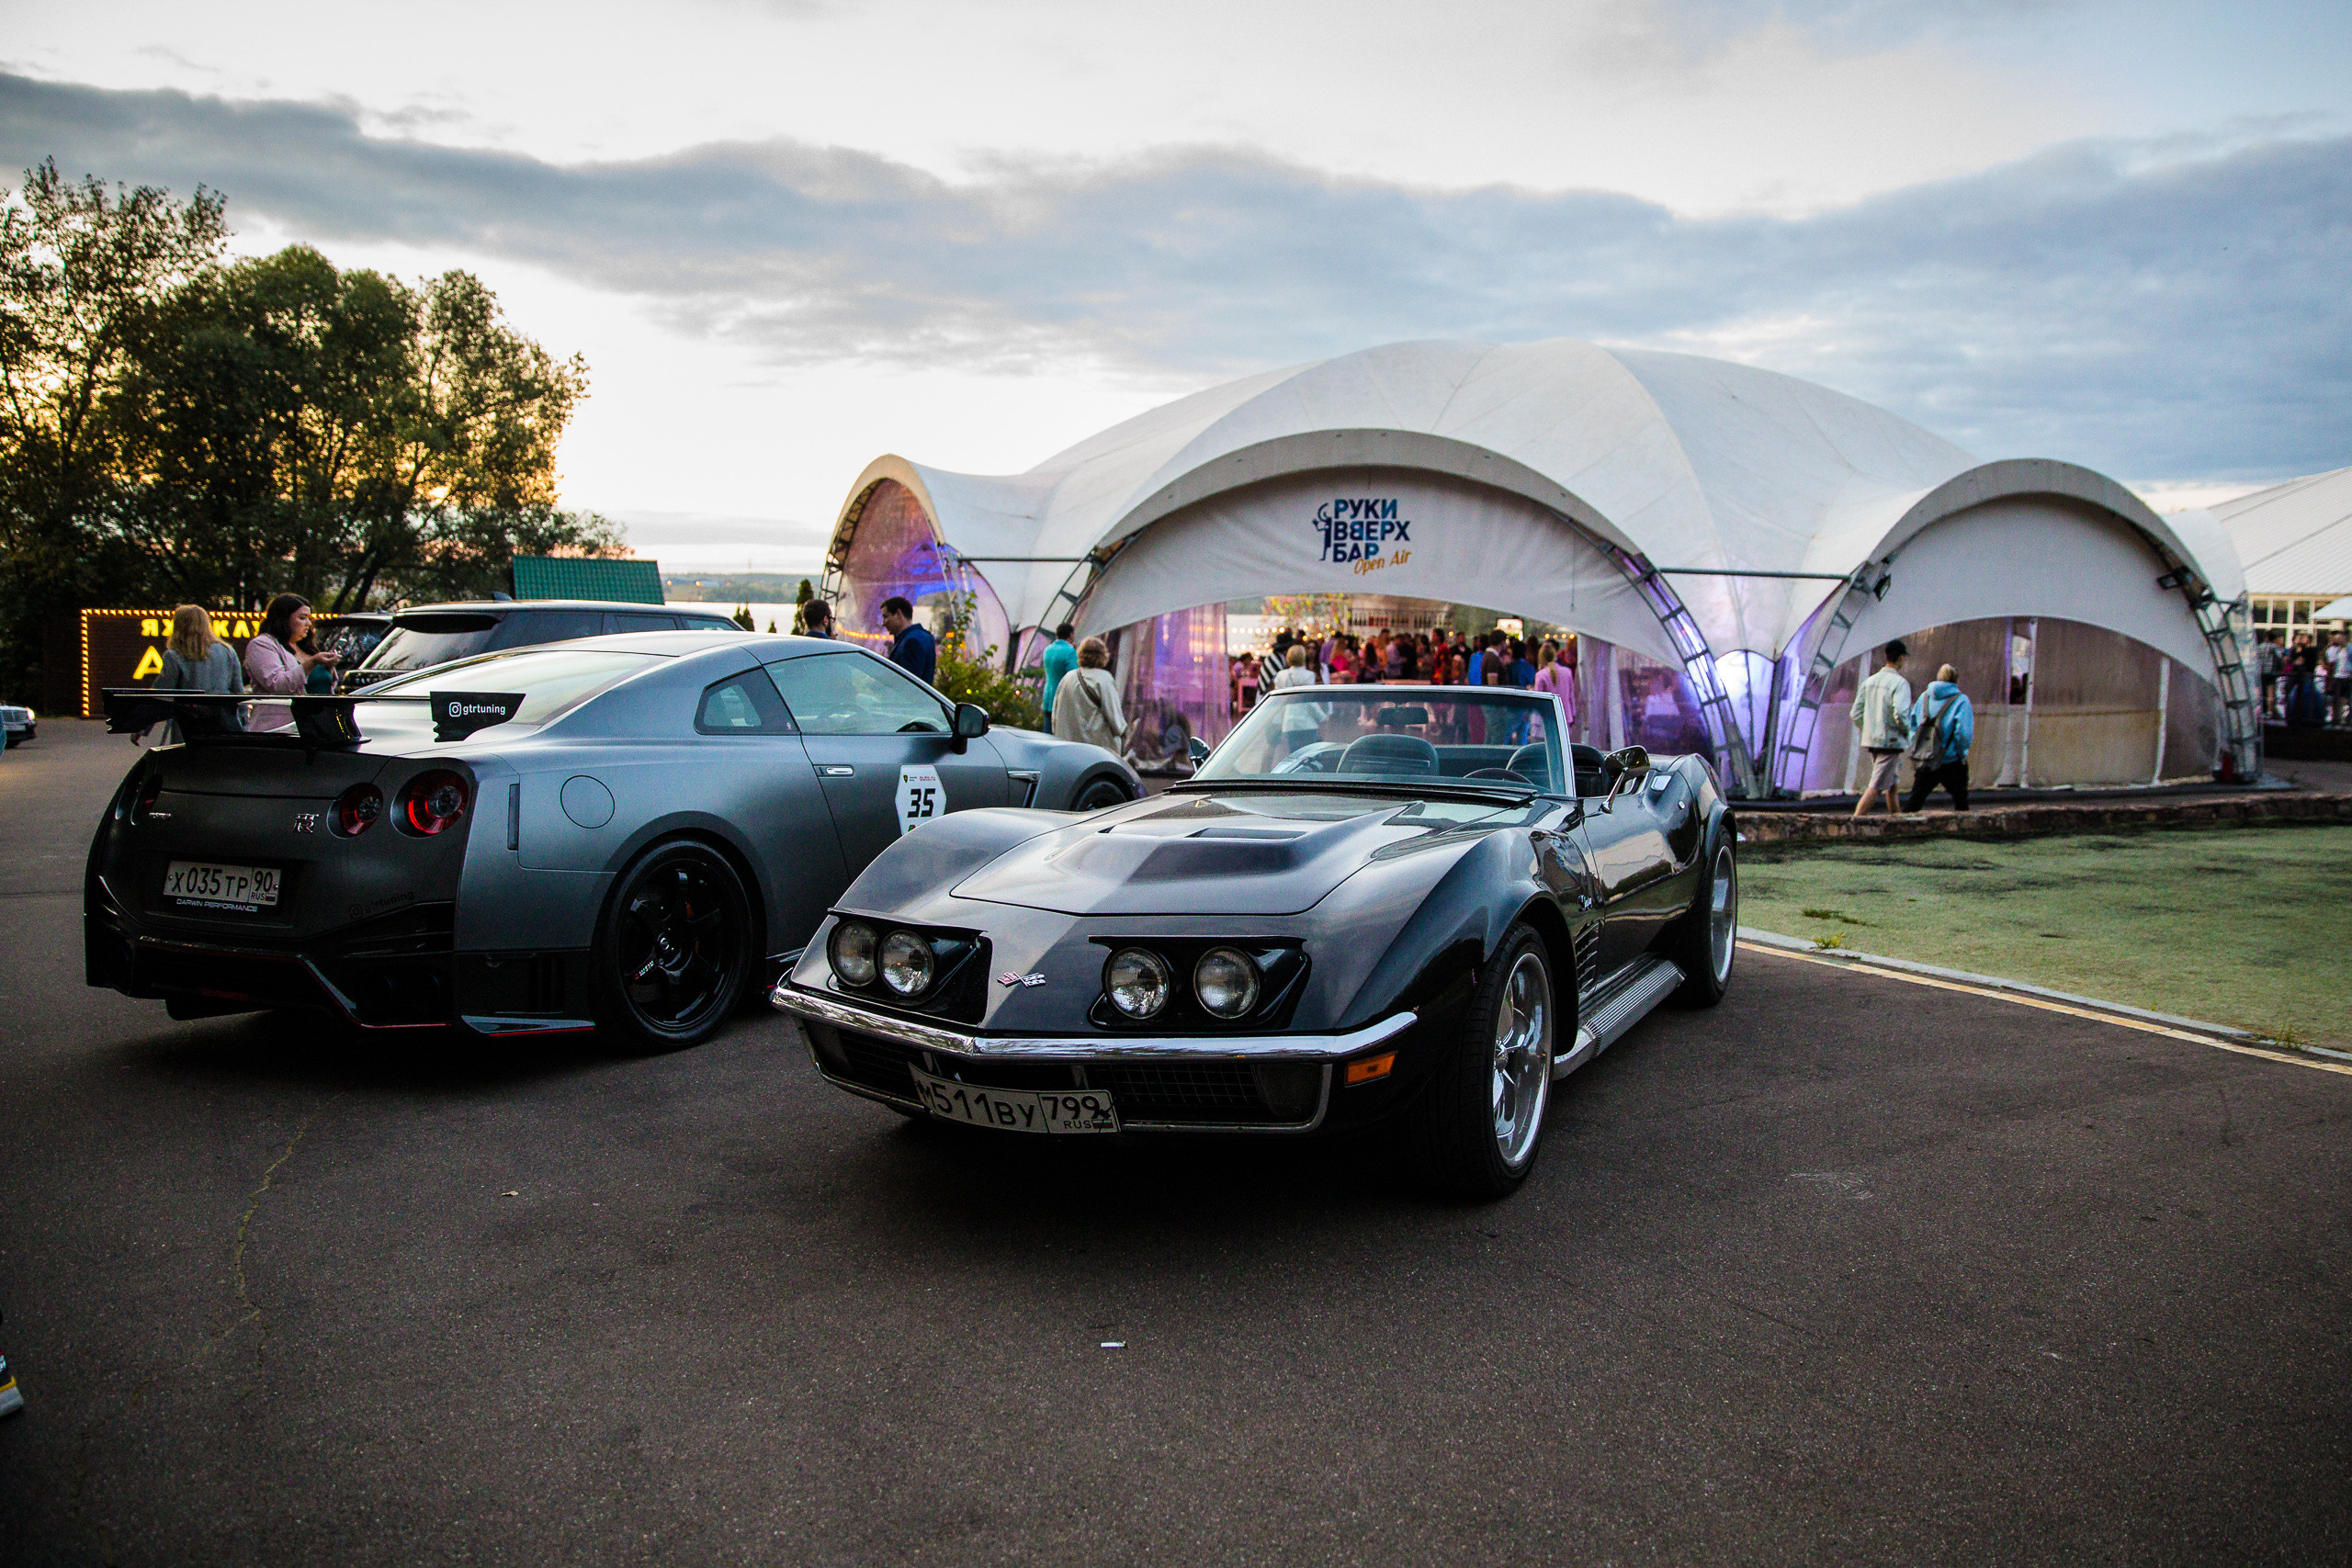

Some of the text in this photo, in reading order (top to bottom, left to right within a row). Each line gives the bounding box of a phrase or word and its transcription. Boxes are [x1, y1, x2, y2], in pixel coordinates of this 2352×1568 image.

[1334, 499, 1398, 520] РУКИ
[1333, 520, 1411, 542] ВВЕРХ
[1332, 542, 1380, 563] БАР
[1353, 549, 1412, 576] Open Air
[462, 704, 506, 716] gtrtuning
[907, 787, 936, 818] 35
[254, 870, 274, 892] 90
[175, 898, 258, 912] DARWIN PERFORMANCE
[250, 892, 266, 900] RUS
[1042, 1096, 1102, 1121] 799
[1063, 1120, 1092, 1129] RUS
